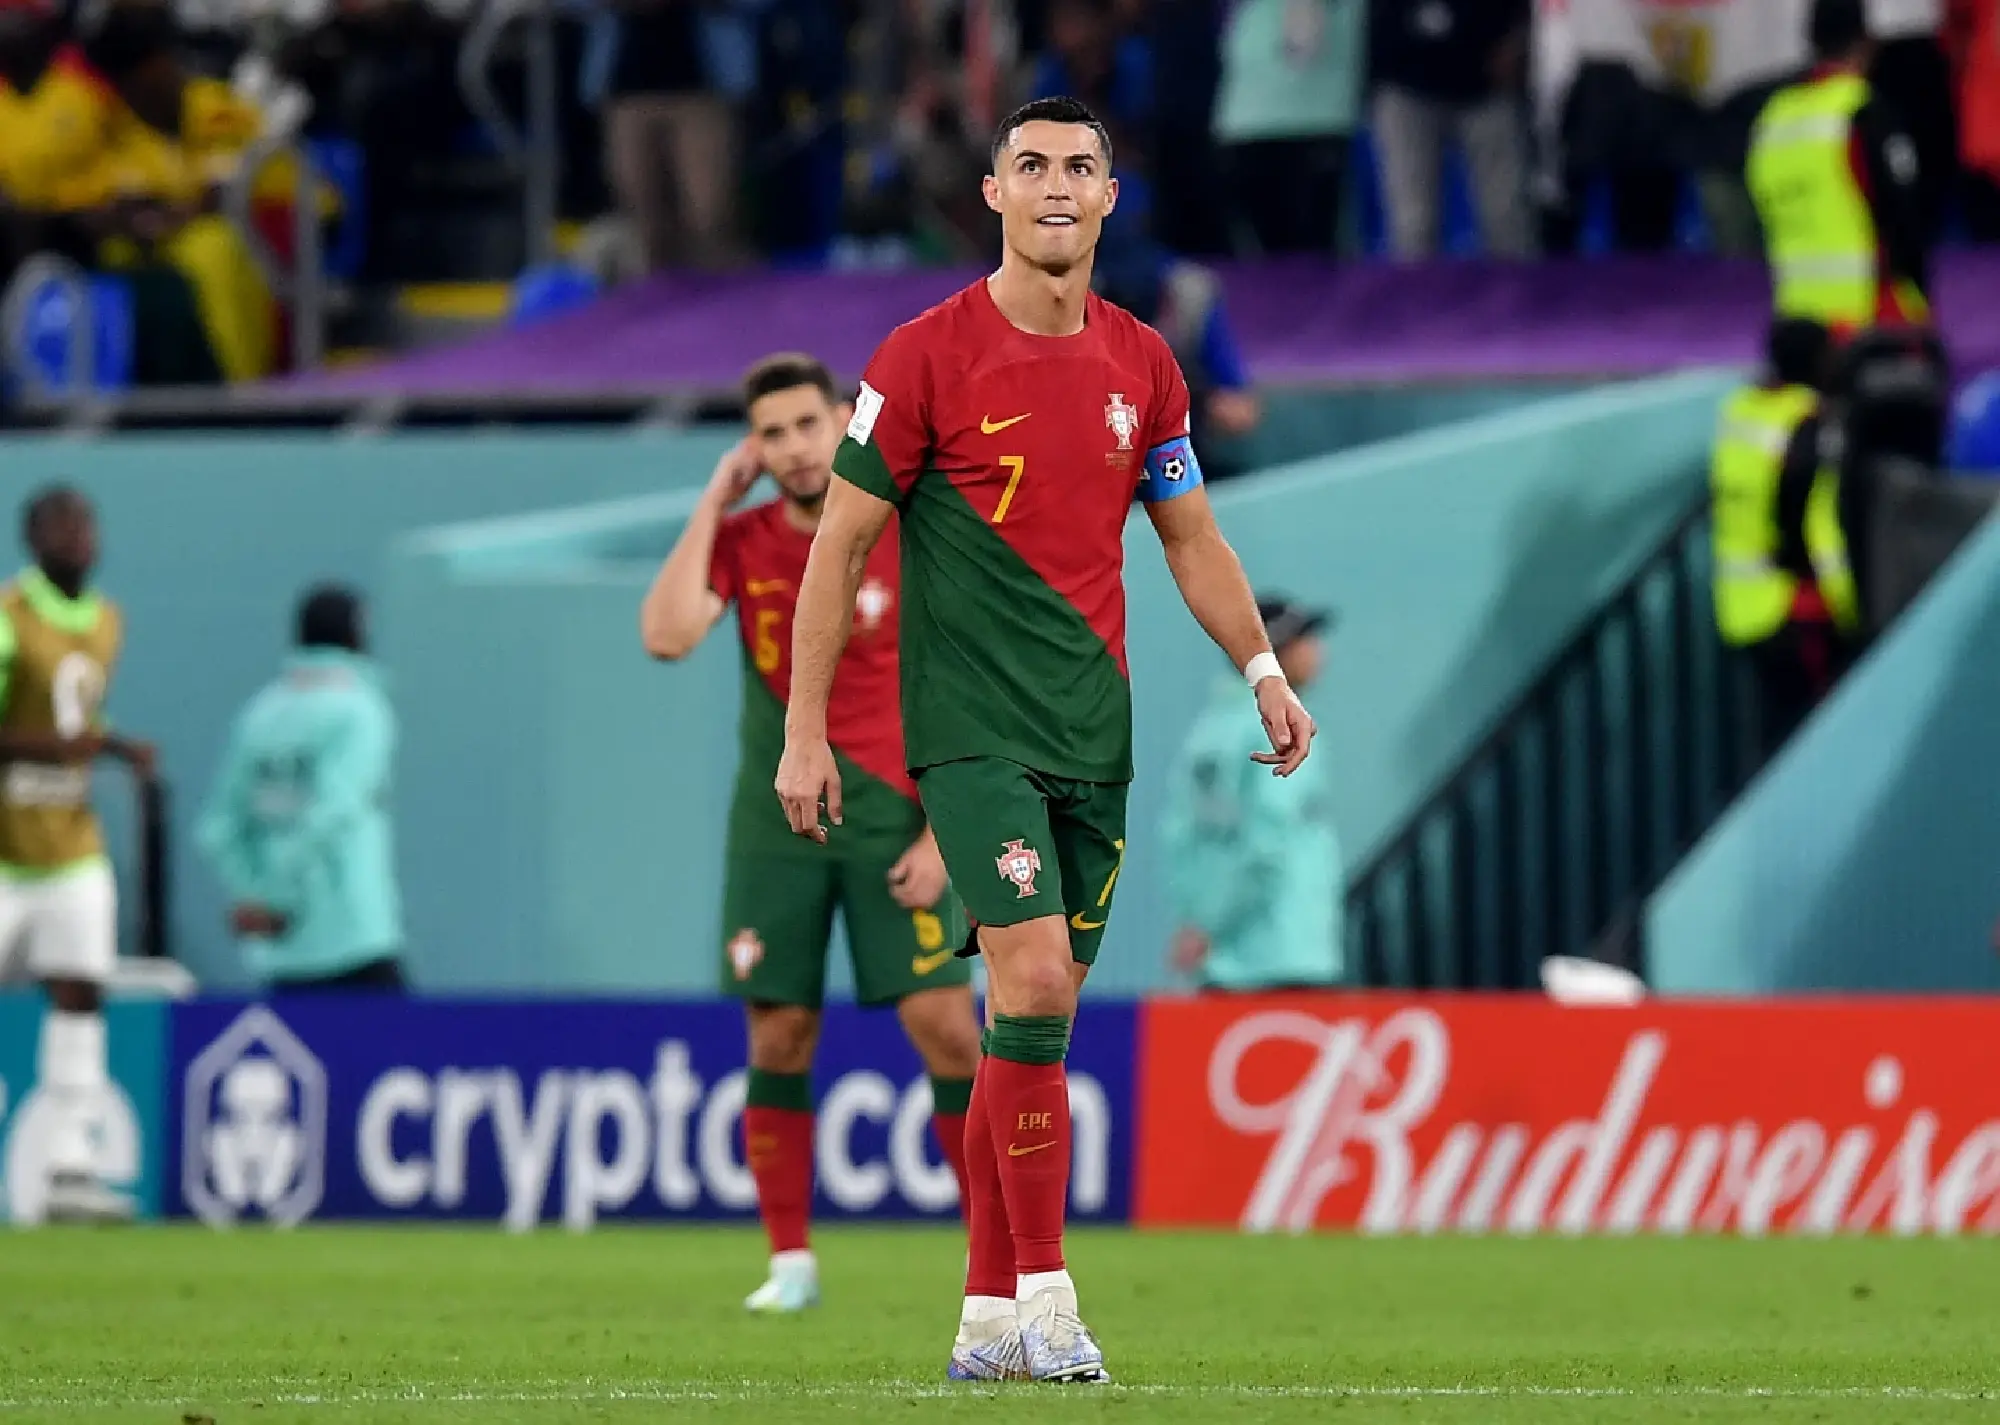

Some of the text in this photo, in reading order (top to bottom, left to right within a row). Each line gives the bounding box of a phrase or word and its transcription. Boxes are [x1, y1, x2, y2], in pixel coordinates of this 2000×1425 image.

[991, 455, 1024, 523] 7
[755, 610, 781, 672] 5
[357, 1037, 1109, 1232] cryptoco
[1207, 1007, 2000, 1237] Budweise
